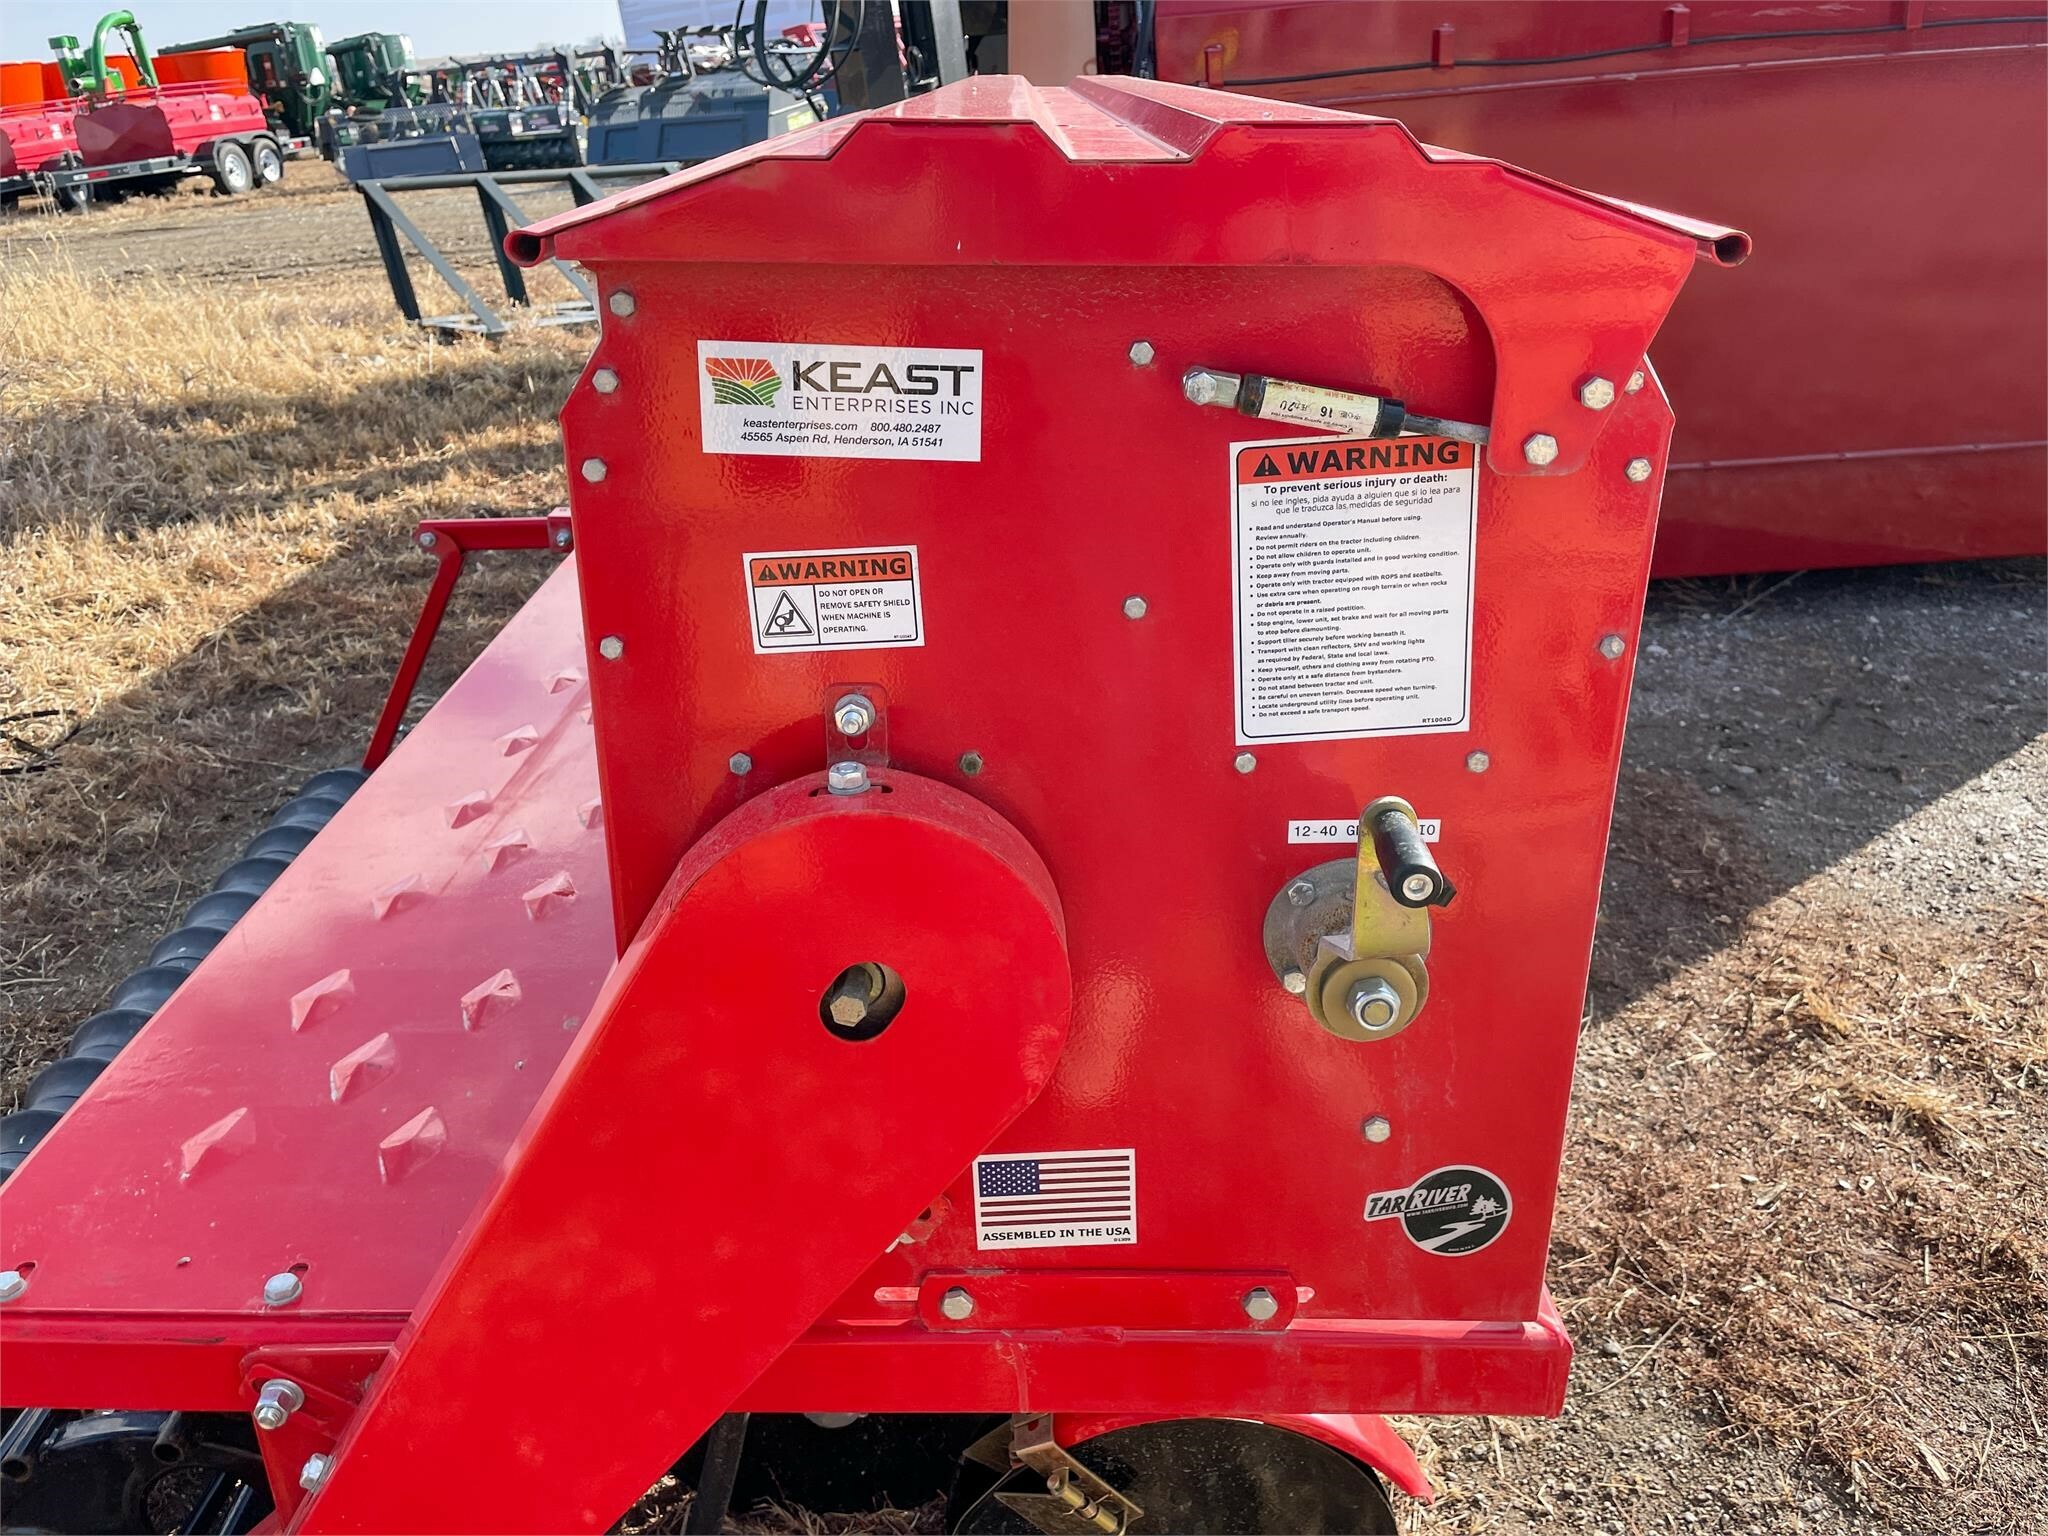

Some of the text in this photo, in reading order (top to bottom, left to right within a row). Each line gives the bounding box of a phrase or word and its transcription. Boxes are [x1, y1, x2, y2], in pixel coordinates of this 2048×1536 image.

[793, 360, 974, 396] KEAST
[794, 396, 974, 415] ENTERPRISES INC
[1320, 406, 1333, 418] 16
[743, 419, 941, 433] keastenterprises.com 800.480.2487
[741, 432, 943, 447] 45565 Aspen Rd, Henderson, IA 51541
[1288, 440, 1460, 474] WARNING
[1264, 485, 1278, 495] To
[1280, 482, 1321, 495] prevent
[1323, 480, 1363, 491] serious
[1365, 477, 1397, 488] injury
[1413, 473, 1448, 484] death:
[1251, 500, 1258, 508] si
[1271, 498, 1284, 506] lee
[1312, 495, 1330, 505] pida
[1330, 493, 1355, 503] ayuda
[1362, 491, 1393, 501] alguien
[1394, 490, 1410, 499] que
[1411, 488, 1419, 497] si
[1420, 488, 1428, 496] lo
[1443, 487, 1461, 496] para
[1275, 496, 1433, 515] que le traduzca las medidas de seguridad
[1285, 521, 1322, 530] understand
[1277, 542, 1299, 551] permit
[1312, 558, 1335, 567] guards
[1384, 554, 1400, 562] good
[778, 558, 906, 579] WARNING
[1335, 576, 1364, 584] equipped
[820, 601, 852, 610] REMOVE
[854, 600, 881, 608] SAFETY
[1279, 700, 1319, 708] underground
[1295, 826, 1337, 836] 12-40
[983, 1227, 1130, 1241] ASSEMBLED IN THE USA
